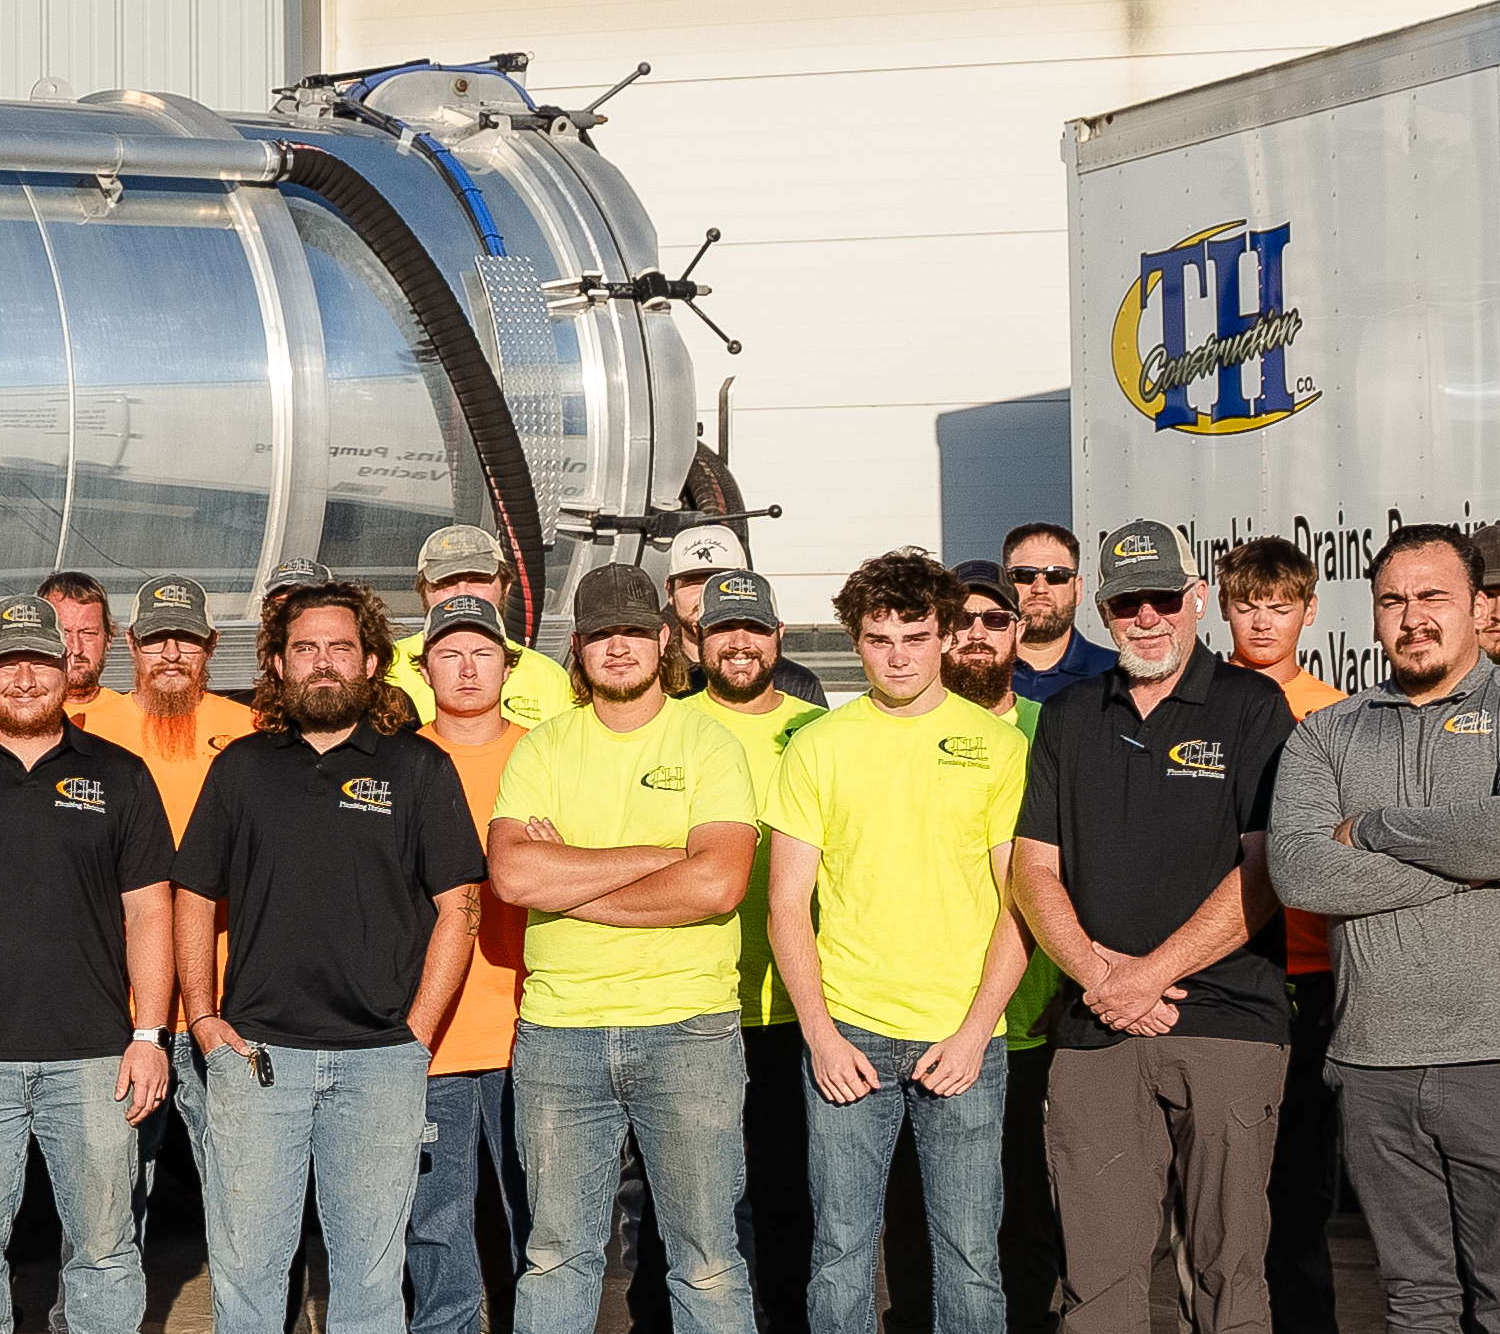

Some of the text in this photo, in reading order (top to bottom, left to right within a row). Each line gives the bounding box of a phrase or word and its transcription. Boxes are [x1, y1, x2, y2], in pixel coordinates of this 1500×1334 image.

[1139, 307, 1302, 403] Construction
[1140, 221, 1295, 433] TH
[1296, 376, 1316, 393] CO.
[1328, 631, 1392, 695] Vacin
